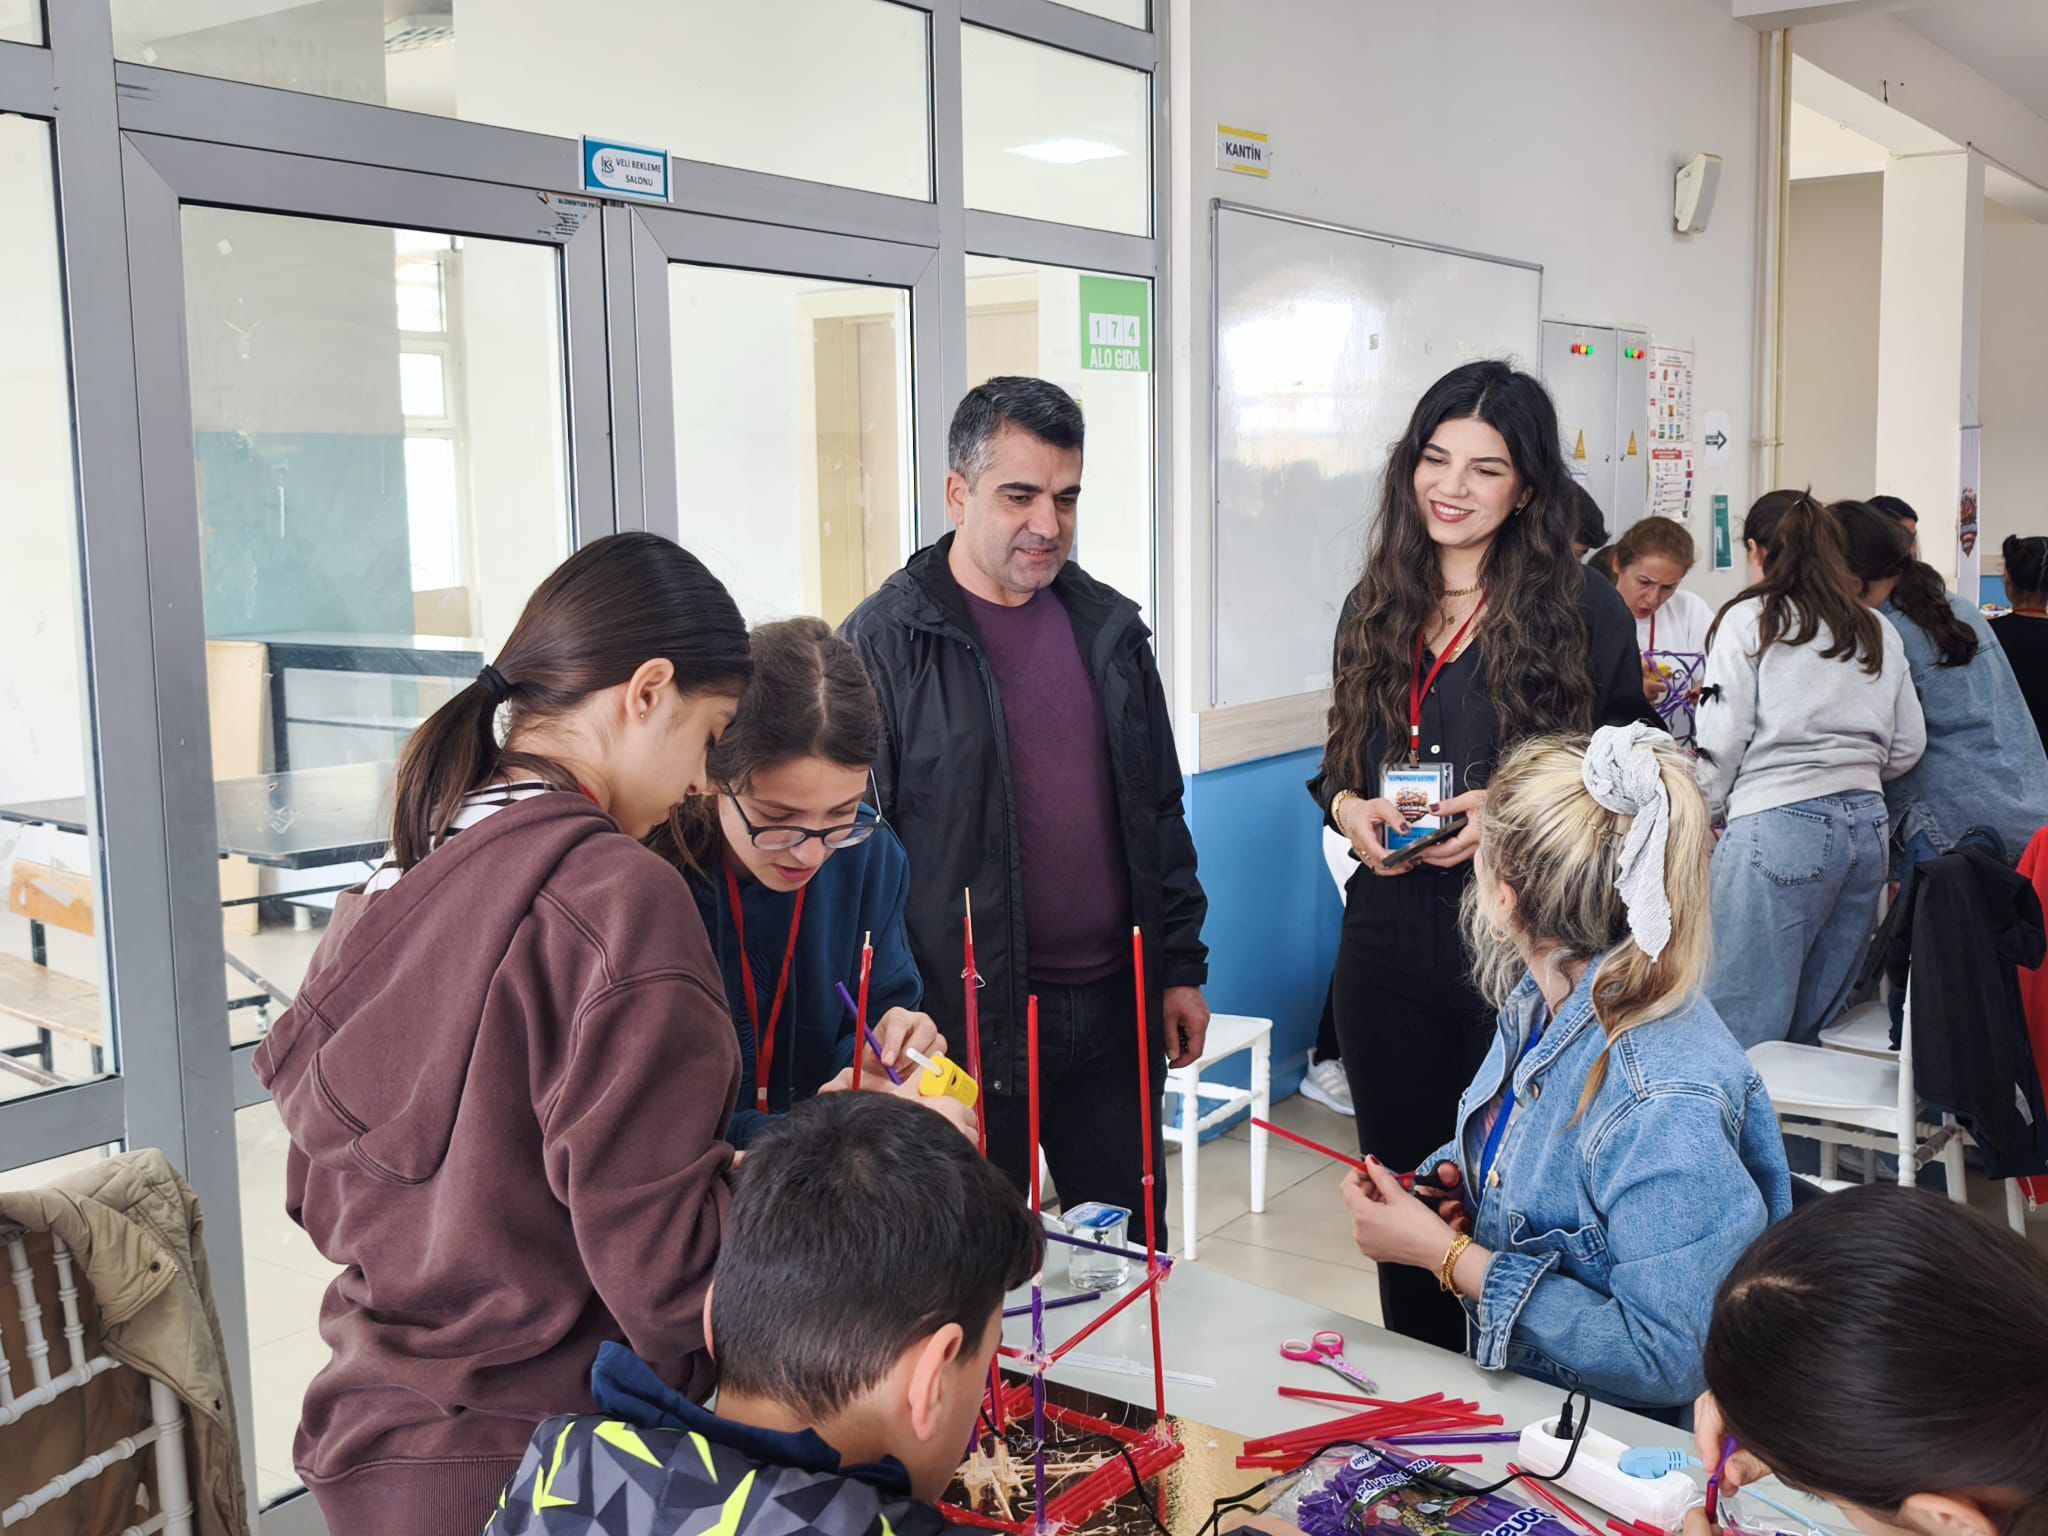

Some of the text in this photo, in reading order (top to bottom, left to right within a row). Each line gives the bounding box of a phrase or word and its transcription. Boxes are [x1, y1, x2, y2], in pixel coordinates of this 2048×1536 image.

[1225, 141, 1261, 161] KANTİN
[616, 158, 661, 173] VELİ BEKLEME
[625, 175, 653, 186] SALONU
[1090, 347, 1141, 370] ALO GIDA
